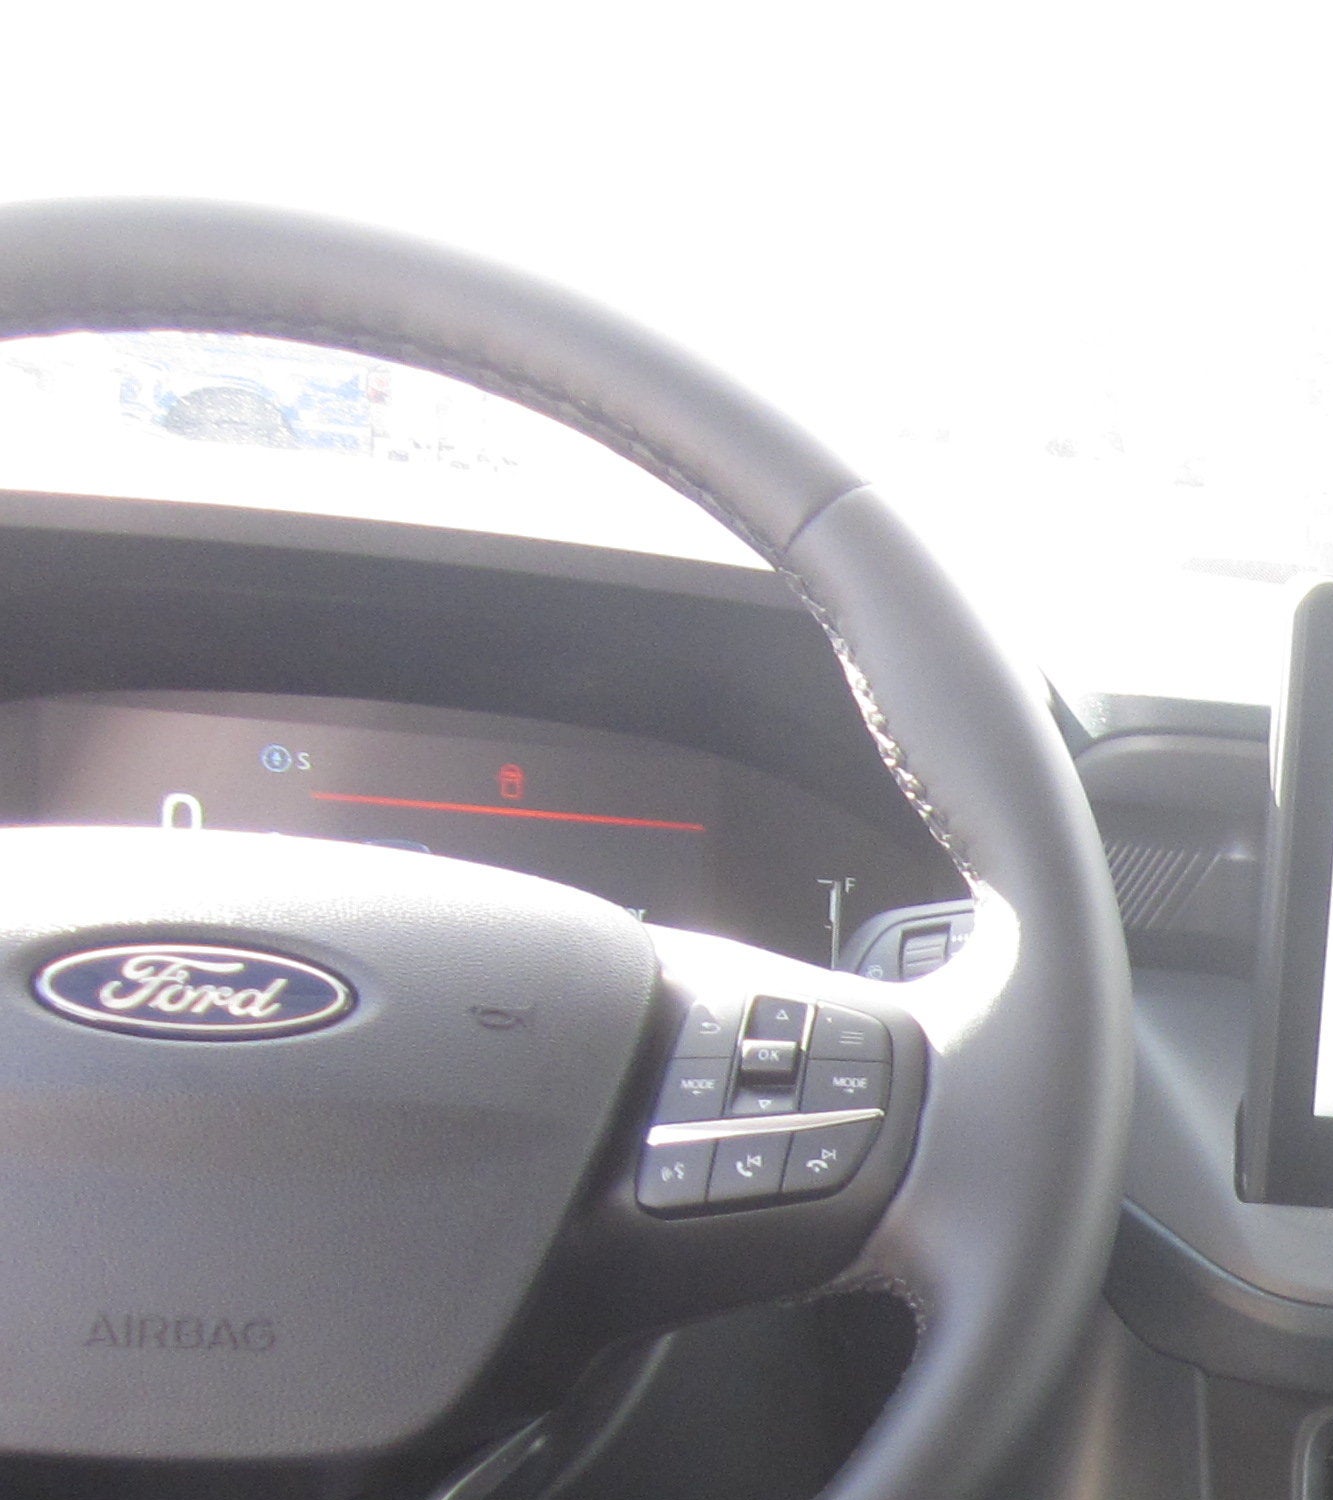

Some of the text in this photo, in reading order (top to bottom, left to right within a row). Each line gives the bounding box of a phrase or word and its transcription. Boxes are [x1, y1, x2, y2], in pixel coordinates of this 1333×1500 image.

[297, 752, 311, 770] S
[845, 877, 855, 893] F
[98, 954, 288, 1017] Ford
[757, 1048, 780, 1062] OK
[680, 1078, 716, 1090] MODE
[832, 1077, 867, 1090] MODE
[85, 1313, 278, 1354] AIRBAG
